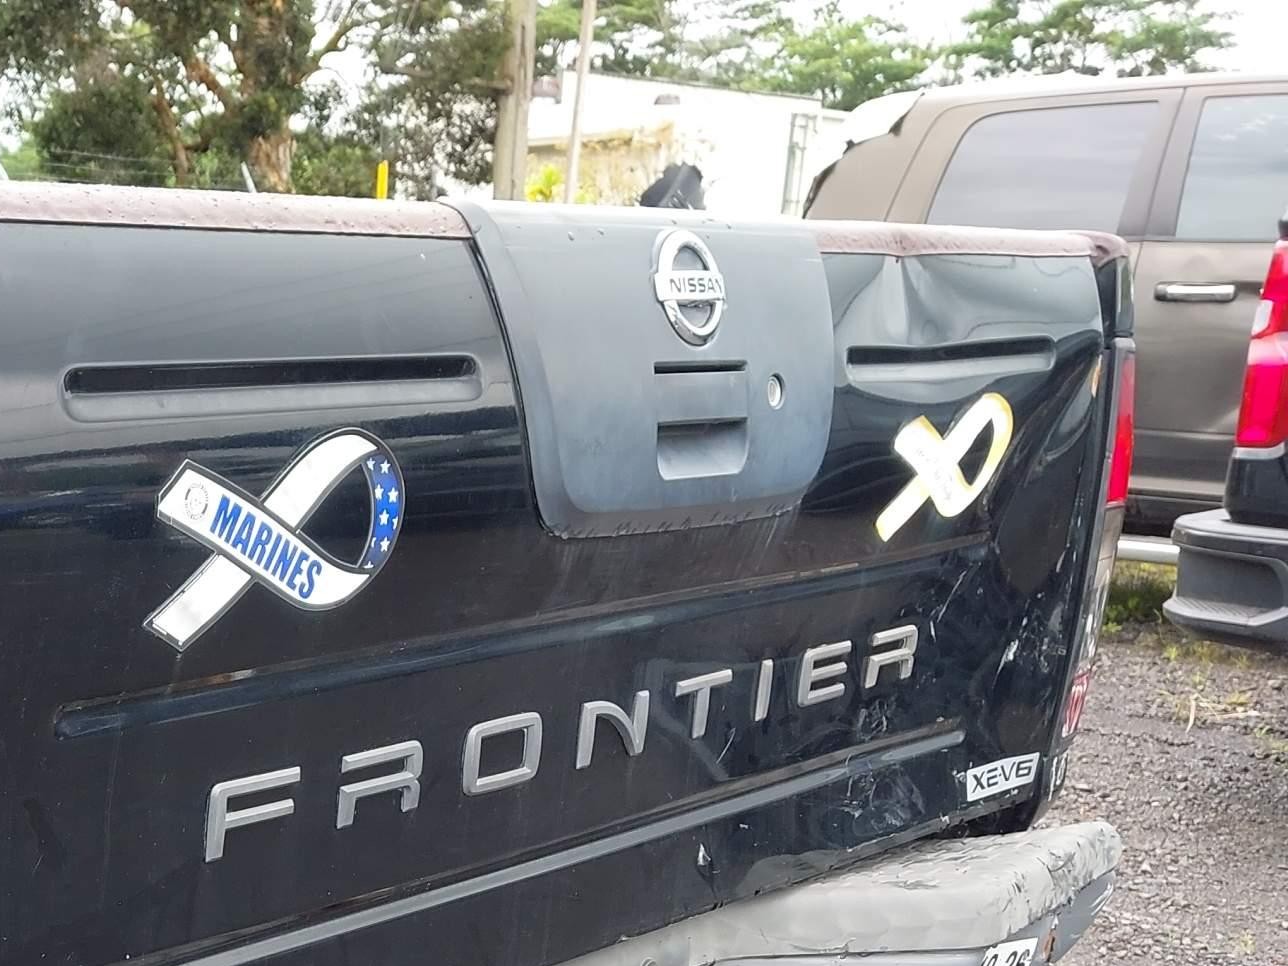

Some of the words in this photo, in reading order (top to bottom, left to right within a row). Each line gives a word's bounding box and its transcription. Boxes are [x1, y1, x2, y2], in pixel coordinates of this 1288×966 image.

[668, 277, 723, 294] NISSAN
[209, 494, 323, 600] MARINES
[203, 623, 918, 863] FRONTIER
